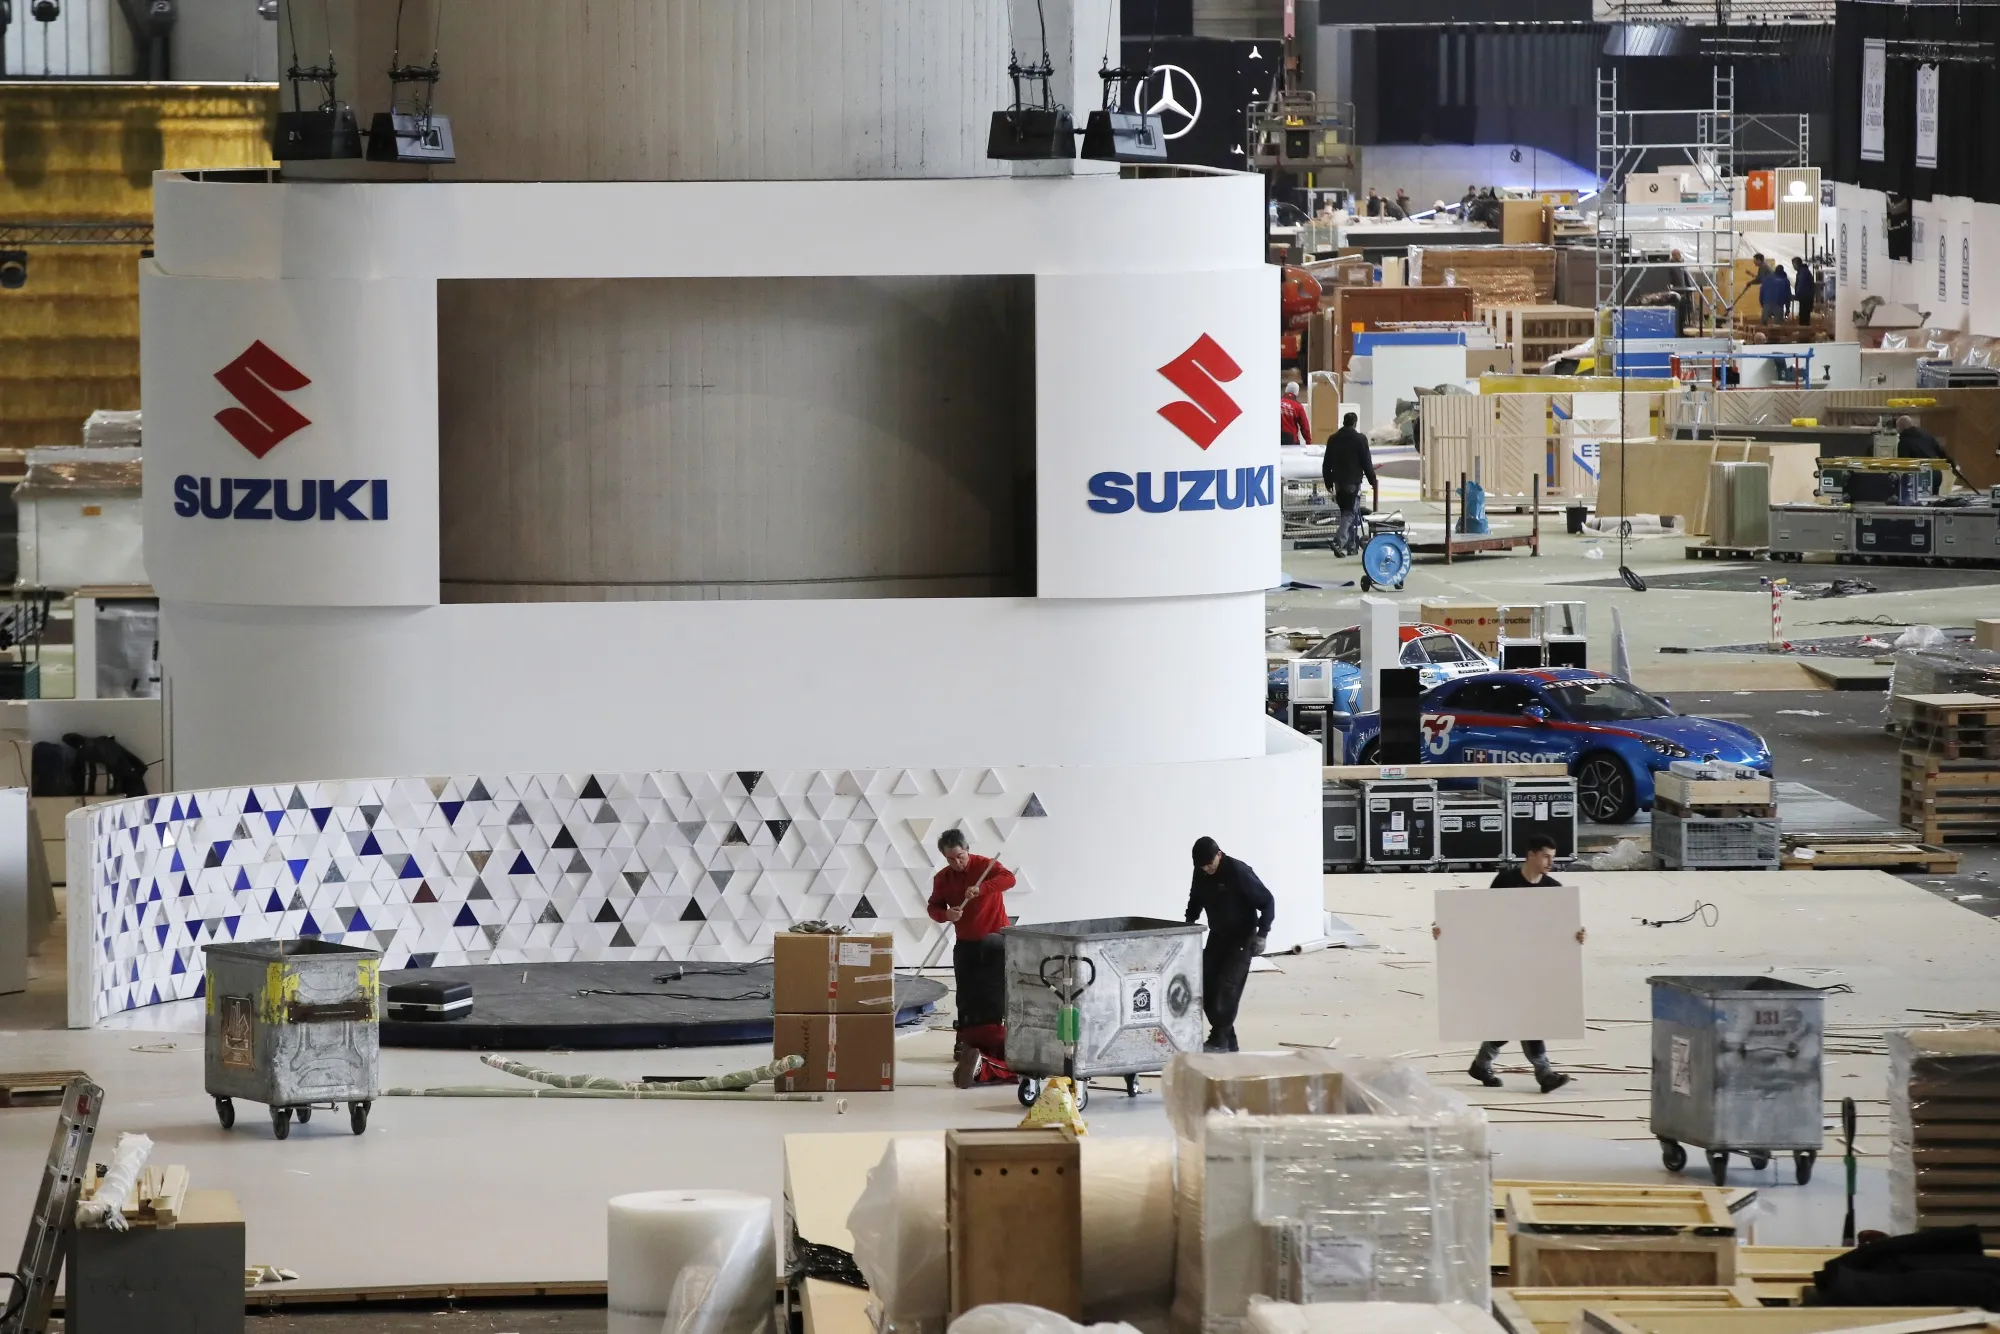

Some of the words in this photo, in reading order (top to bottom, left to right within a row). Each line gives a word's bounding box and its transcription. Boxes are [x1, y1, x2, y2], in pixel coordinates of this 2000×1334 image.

[1088, 465, 1275, 514] SUZUKI
[174, 474, 388, 521] SUZUKI
[1453, 617, 1475, 625] image
[1487, 617, 1531, 625] contruction
[1420, 714, 1456, 755] 53
[1487, 749, 1558, 763] TISSOT
[1538, 793, 1573, 802] STACKER
[1465, 820, 1477, 829] BS
[1754, 1010, 1780, 1026] 131
